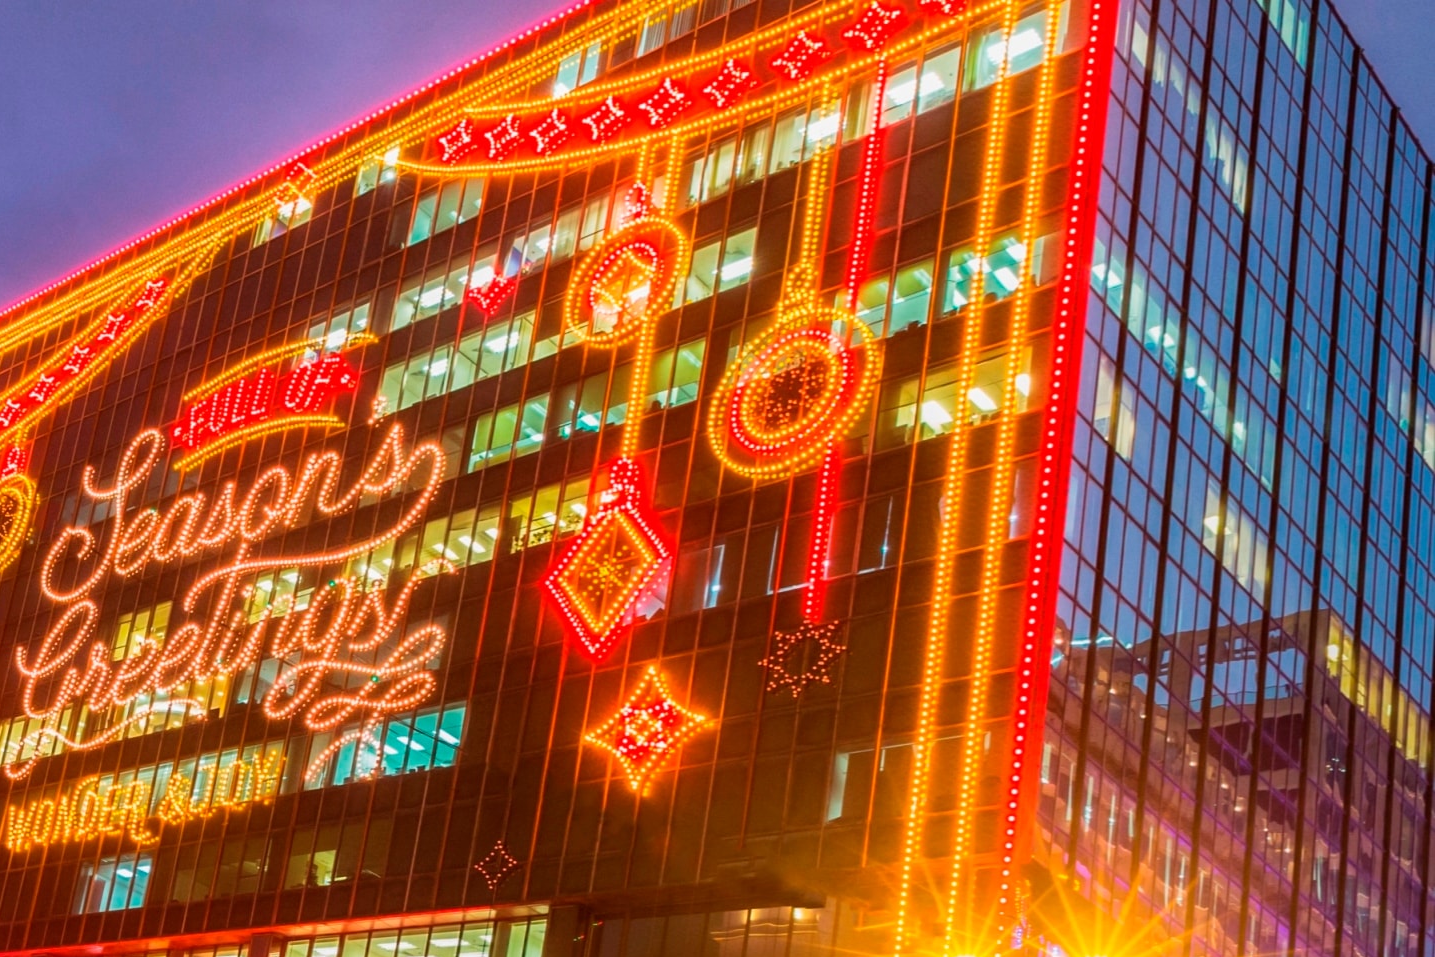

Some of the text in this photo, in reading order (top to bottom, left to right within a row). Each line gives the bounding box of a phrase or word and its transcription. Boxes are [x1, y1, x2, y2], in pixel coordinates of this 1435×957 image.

[189, 356, 341, 449] FULL OF
[11, 556, 456, 745] Greetings
[6, 751, 283, 852] WONDER & JOY
